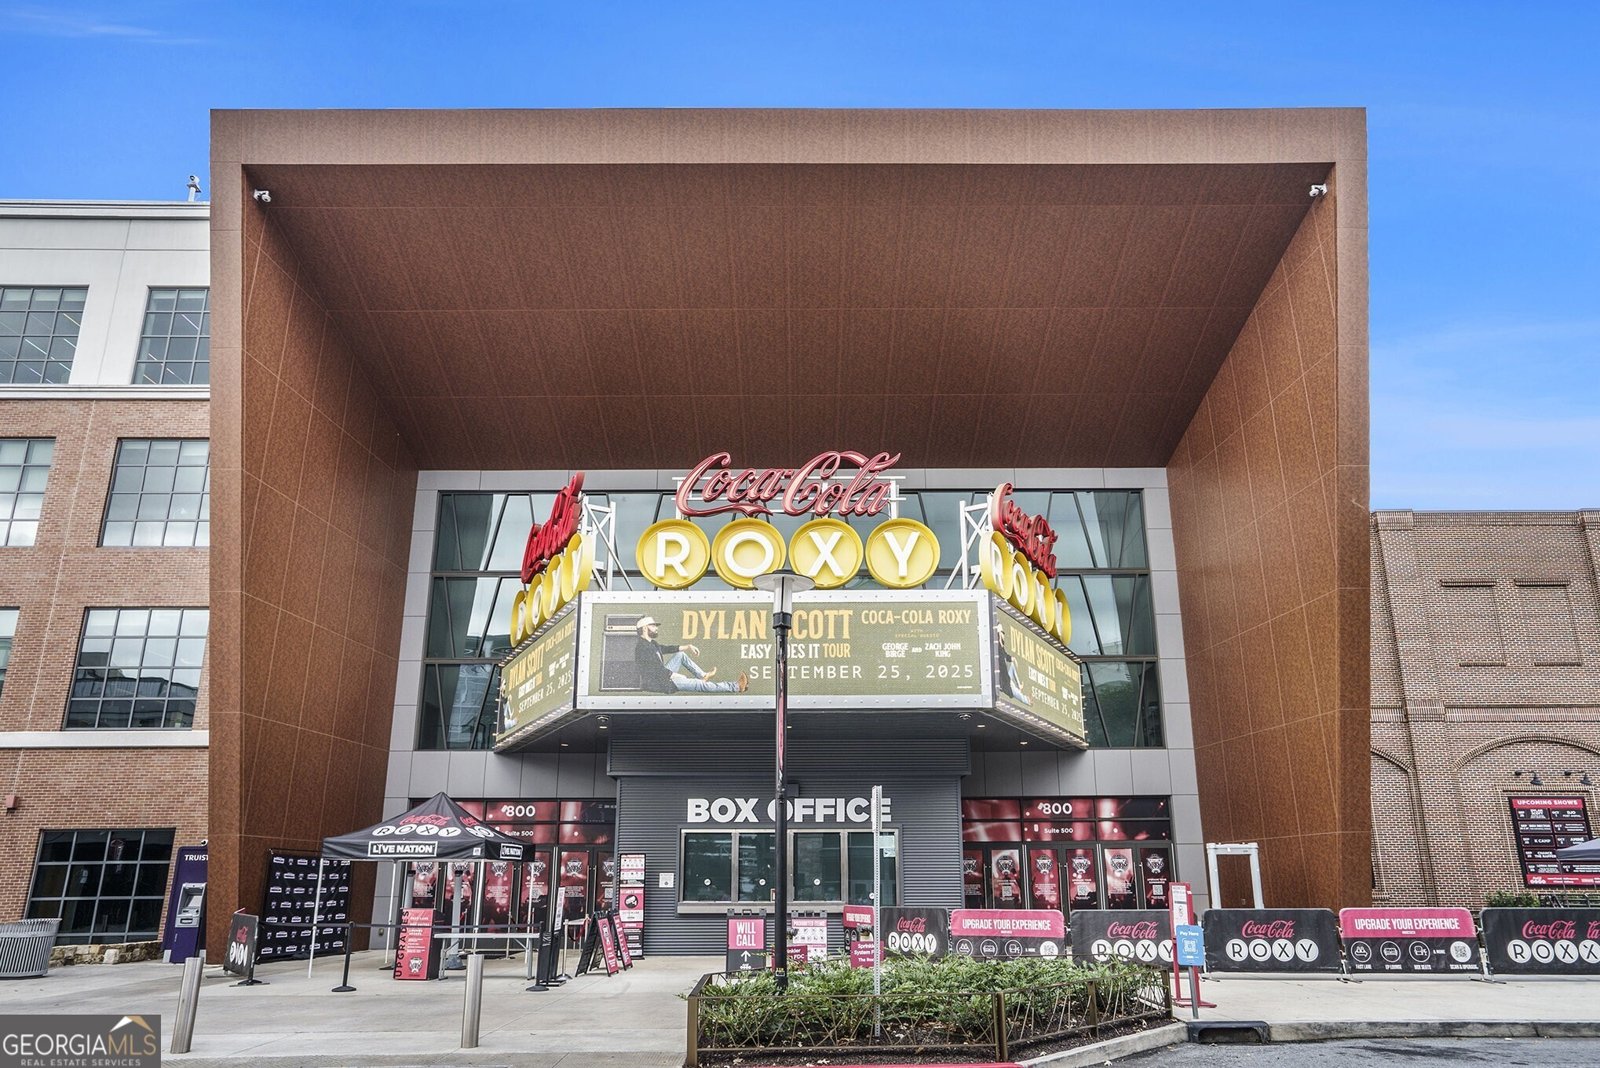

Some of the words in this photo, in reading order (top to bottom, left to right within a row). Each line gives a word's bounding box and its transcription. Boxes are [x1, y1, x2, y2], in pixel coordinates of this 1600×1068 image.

[655, 529, 921, 579] ROXY
[682, 609, 768, 640] DYLAN
[786, 609, 853, 640] COTT
[861, 609, 934, 625] COCA-COLA
[938, 609, 972, 624] ROXY
[741, 643, 772, 659] EASY
[808, 643, 820, 658] IT
[822, 643, 851, 658] TOUR
[882, 642, 909, 651] GEORGE
[925, 642, 942, 651] ZACH
[944, 642, 962, 651] JOHN
[885, 650, 906, 658] BIRGE
[935, 650, 951, 658] KING
[1010, 626, 1036, 666] DYLAN
[1036, 643, 1056, 678] SCOTT
[750, 665, 863, 679] SETEMBER
[878, 665, 911, 681] 25,
[926, 665, 974, 679] 2025
[687, 797, 760, 823] BOX
[374, 825, 459, 836] ROXY
[372, 844, 395, 854] LIVE
[396, 844, 434, 853] NATION
[184, 854, 209, 862] TRUIST
[736, 921, 757, 934] WILL
[962, 918, 992, 930] UPGRADE
[993, 919, 1011, 930] YOUR
[1012, 919, 1052, 931] EXPERIENCE
[1355, 918, 1392, 930] UPGRADE
[1392, 918, 1413, 930] YOUR
[1414, 918, 1460, 930] EXPERIENCE
[394, 910, 410, 977] UPGRADES
[736, 934, 757, 947] CALL
[890, 935, 934, 952] ROXY
[1096, 943, 1173, 958] ROXY
[1231, 942, 1313, 959] ROXY
